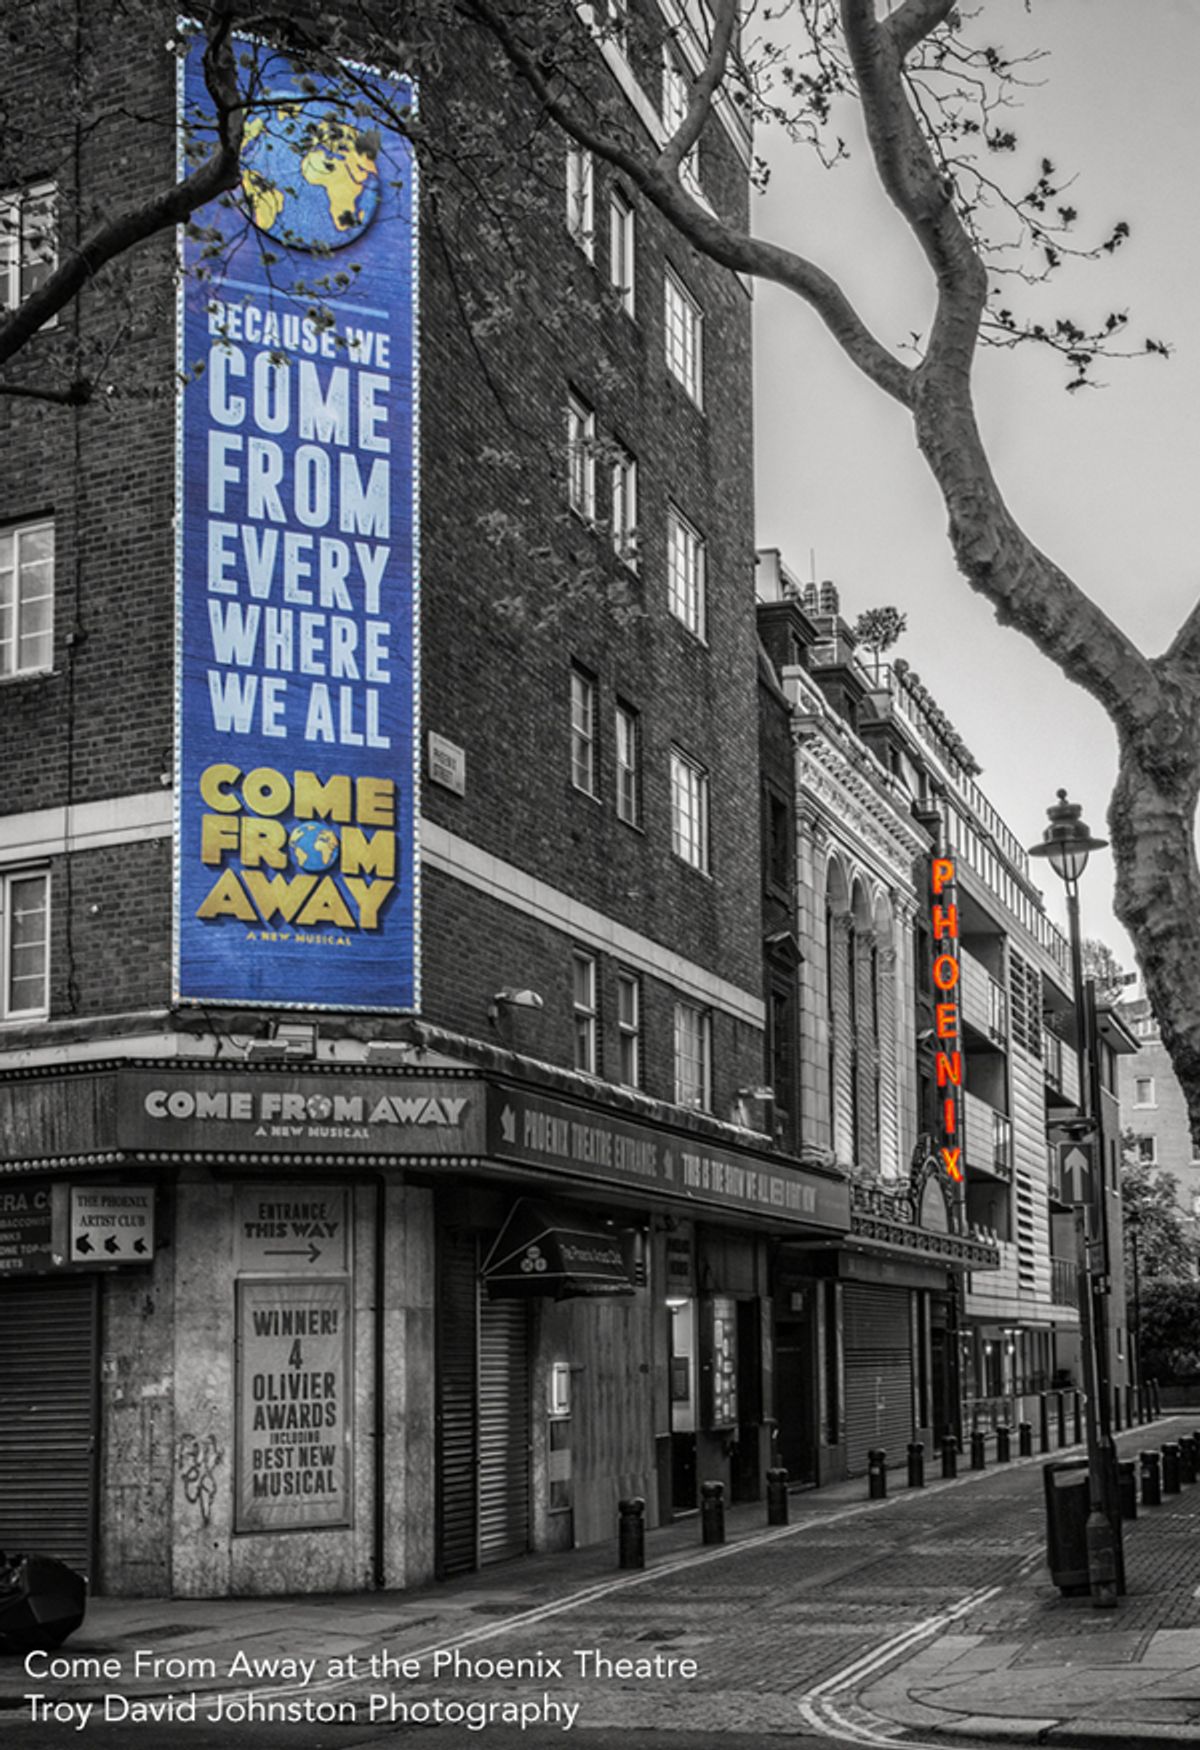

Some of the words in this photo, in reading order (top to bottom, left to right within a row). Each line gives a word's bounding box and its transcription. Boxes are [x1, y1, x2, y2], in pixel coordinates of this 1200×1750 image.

[208, 300, 338, 360] BECAUSE
[344, 326, 391, 369] WE
[208, 344, 391, 453] COME
[208, 430, 391, 538] FROM
[207, 519, 391, 615] EVERY
[207, 599, 391, 684] WHERE
[207, 670, 287, 738] WE
[304, 683, 391, 749] ALL
[200, 764, 395, 826] COME
[201, 814, 396, 878] FROM
[195, 868, 396, 930] AWAY
[246, 930, 257, 941] A
[261, 932, 291, 943] NEW
[295, 934, 352, 946] MUSICAL
[932, 857, 964, 1183] PHOENIX
[144, 1090, 252, 1120] COME
[261, 1093, 363, 1122] FROM
[369, 1096, 469, 1126] AWAY
[254, 1126, 268, 1137] A
[270, 1126, 303, 1138] NEW
[308, 1127, 370, 1139] MUSICAL
[524, 1109, 569, 1157] PHOENIX
[571, 1121, 612, 1168] THEATRE
[614, 1134, 657, 1177] ENTRANCE
[77, 1195, 99, 1207] THE
[101, 1196, 148, 1208] PHOENIX
[258, 1203, 329, 1221] ENTRANCE
[80, 1214, 118, 1227] ARTIST
[118, 1215, 146, 1227] CLUB
[244, 1222, 287, 1239] THIS
[289, 1222, 340, 1239] WAY
[253, 1310, 338, 1337] WINNER!
[288, 1338, 303, 1370] 4
[253, 1372, 337, 1401] OLIVIER
[253, 1401, 337, 1431] AWARDS
[270, 1430, 321, 1446] INCLUDING
[253, 1447, 295, 1471] BEST
[299, 1445, 337, 1469] NEW
[253, 1470, 338, 1498] MUSICAL
